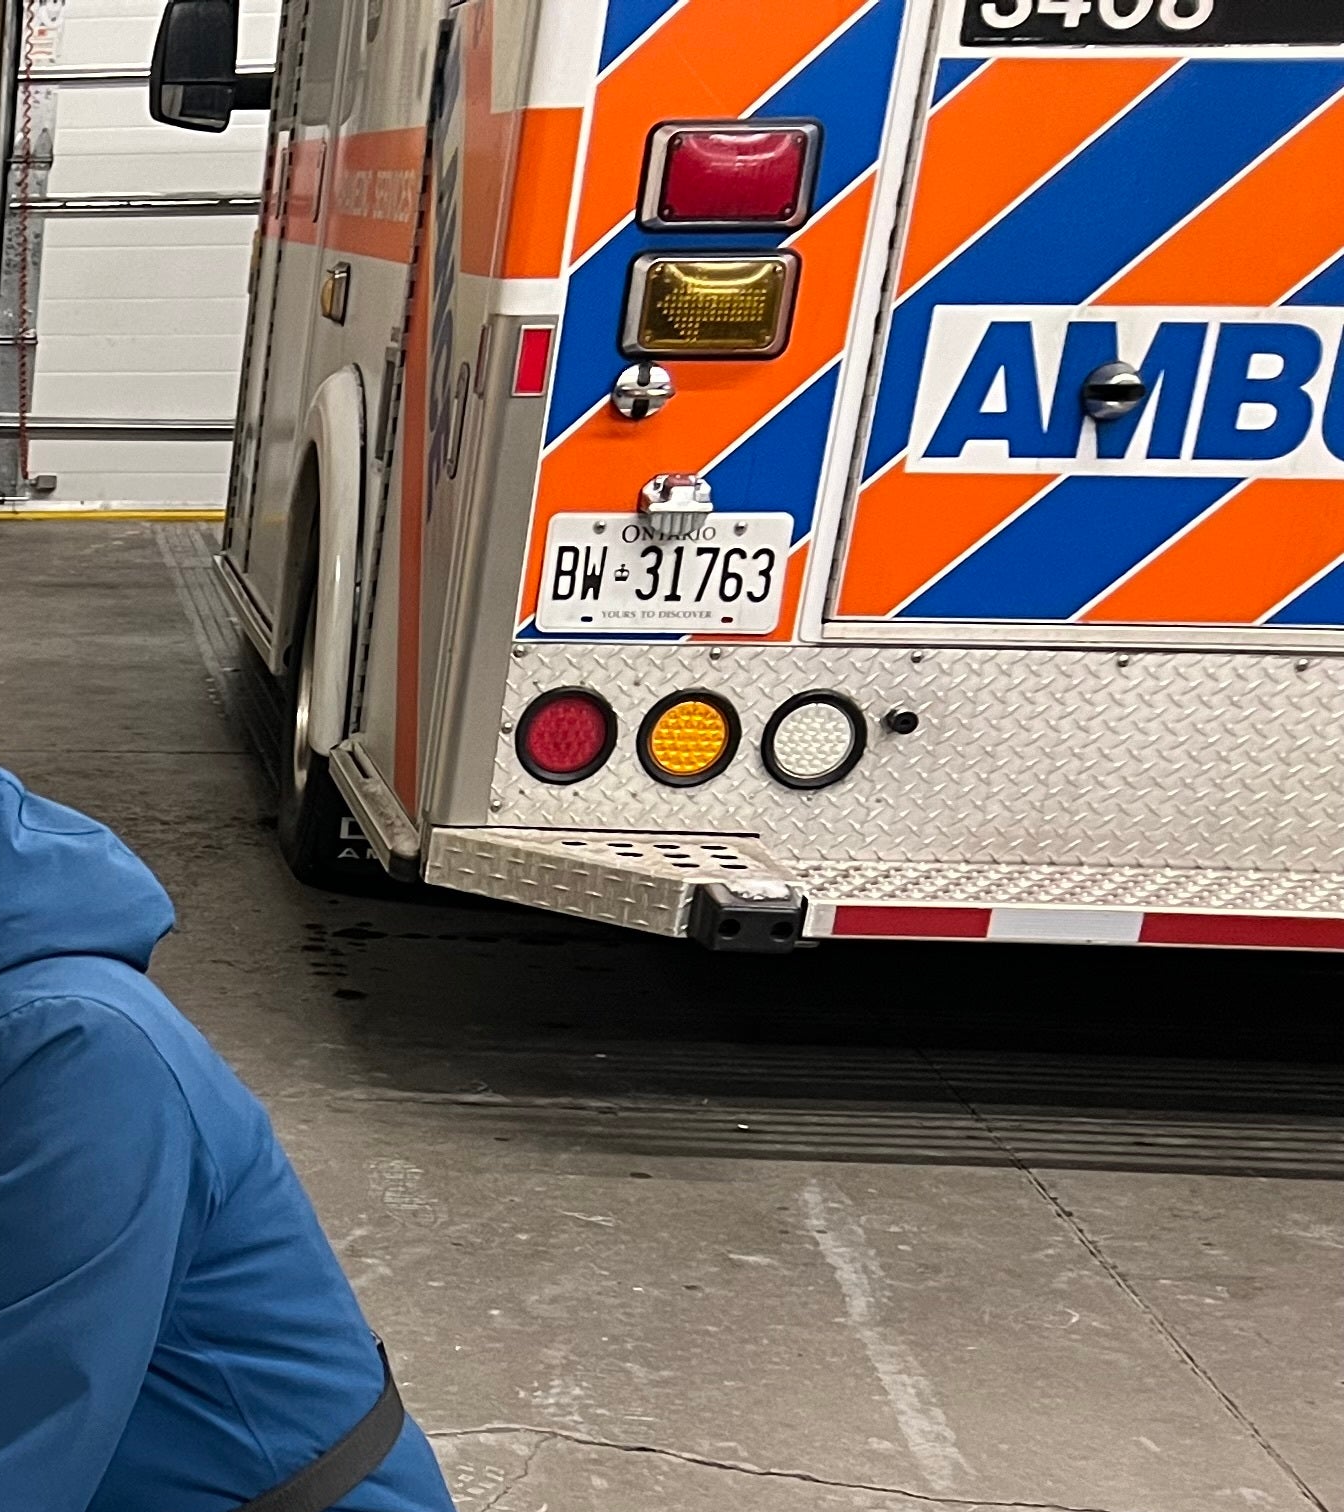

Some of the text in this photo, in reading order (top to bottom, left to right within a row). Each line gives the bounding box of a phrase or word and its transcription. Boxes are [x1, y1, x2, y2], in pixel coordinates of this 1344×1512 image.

[921, 320, 1344, 461] AMB
[551, 545, 776, 603] BW 31763
[601, 610, 712, 619] YOURS TO DISCOVER
